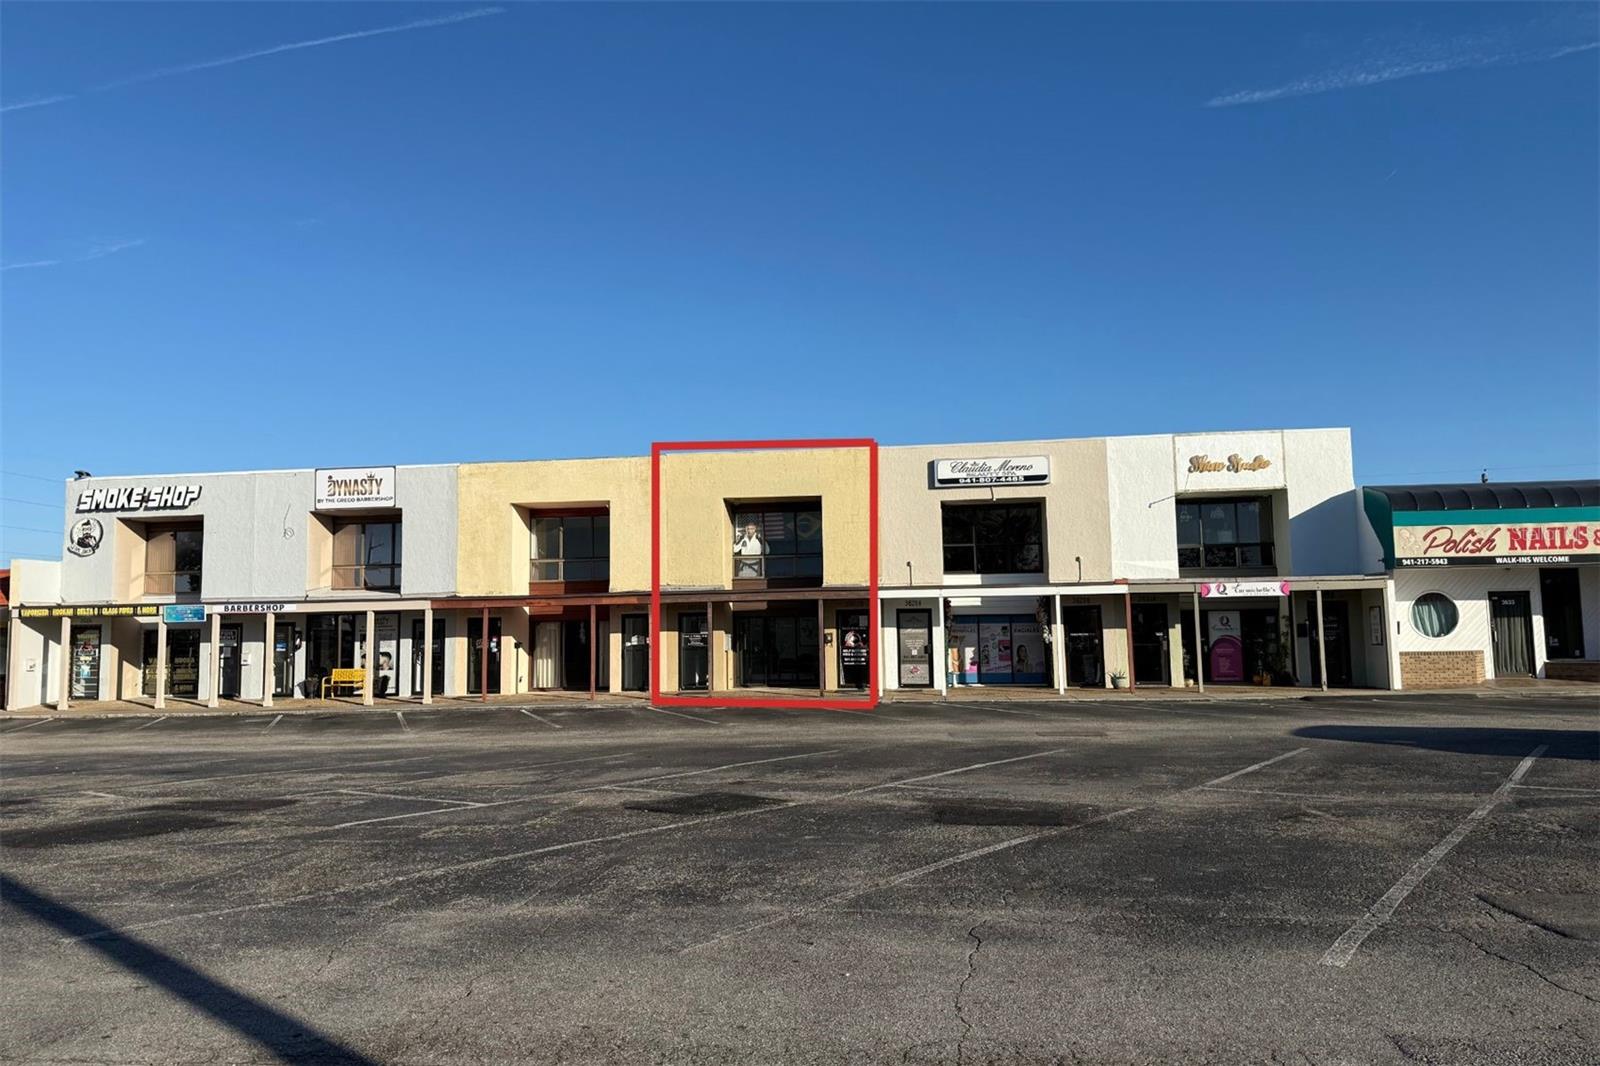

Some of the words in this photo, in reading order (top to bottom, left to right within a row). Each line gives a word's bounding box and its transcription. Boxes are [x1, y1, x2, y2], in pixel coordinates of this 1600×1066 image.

[950, 460, 993, 474] Claudia
[994, 459, 1033, 472] Moreno
[327, 475, 383, 497] DYNASTY
[77, 487, 144, 513] SMOKE
[145, 485, 202, 511] SHOP
[1422, 526, 1501, 555] Polish
[1507, 526, 1590, 551] NAILS
[1533, 555, 1569, 563] WELCOME
[224, 604, 285, 612] BARBERSHOP
